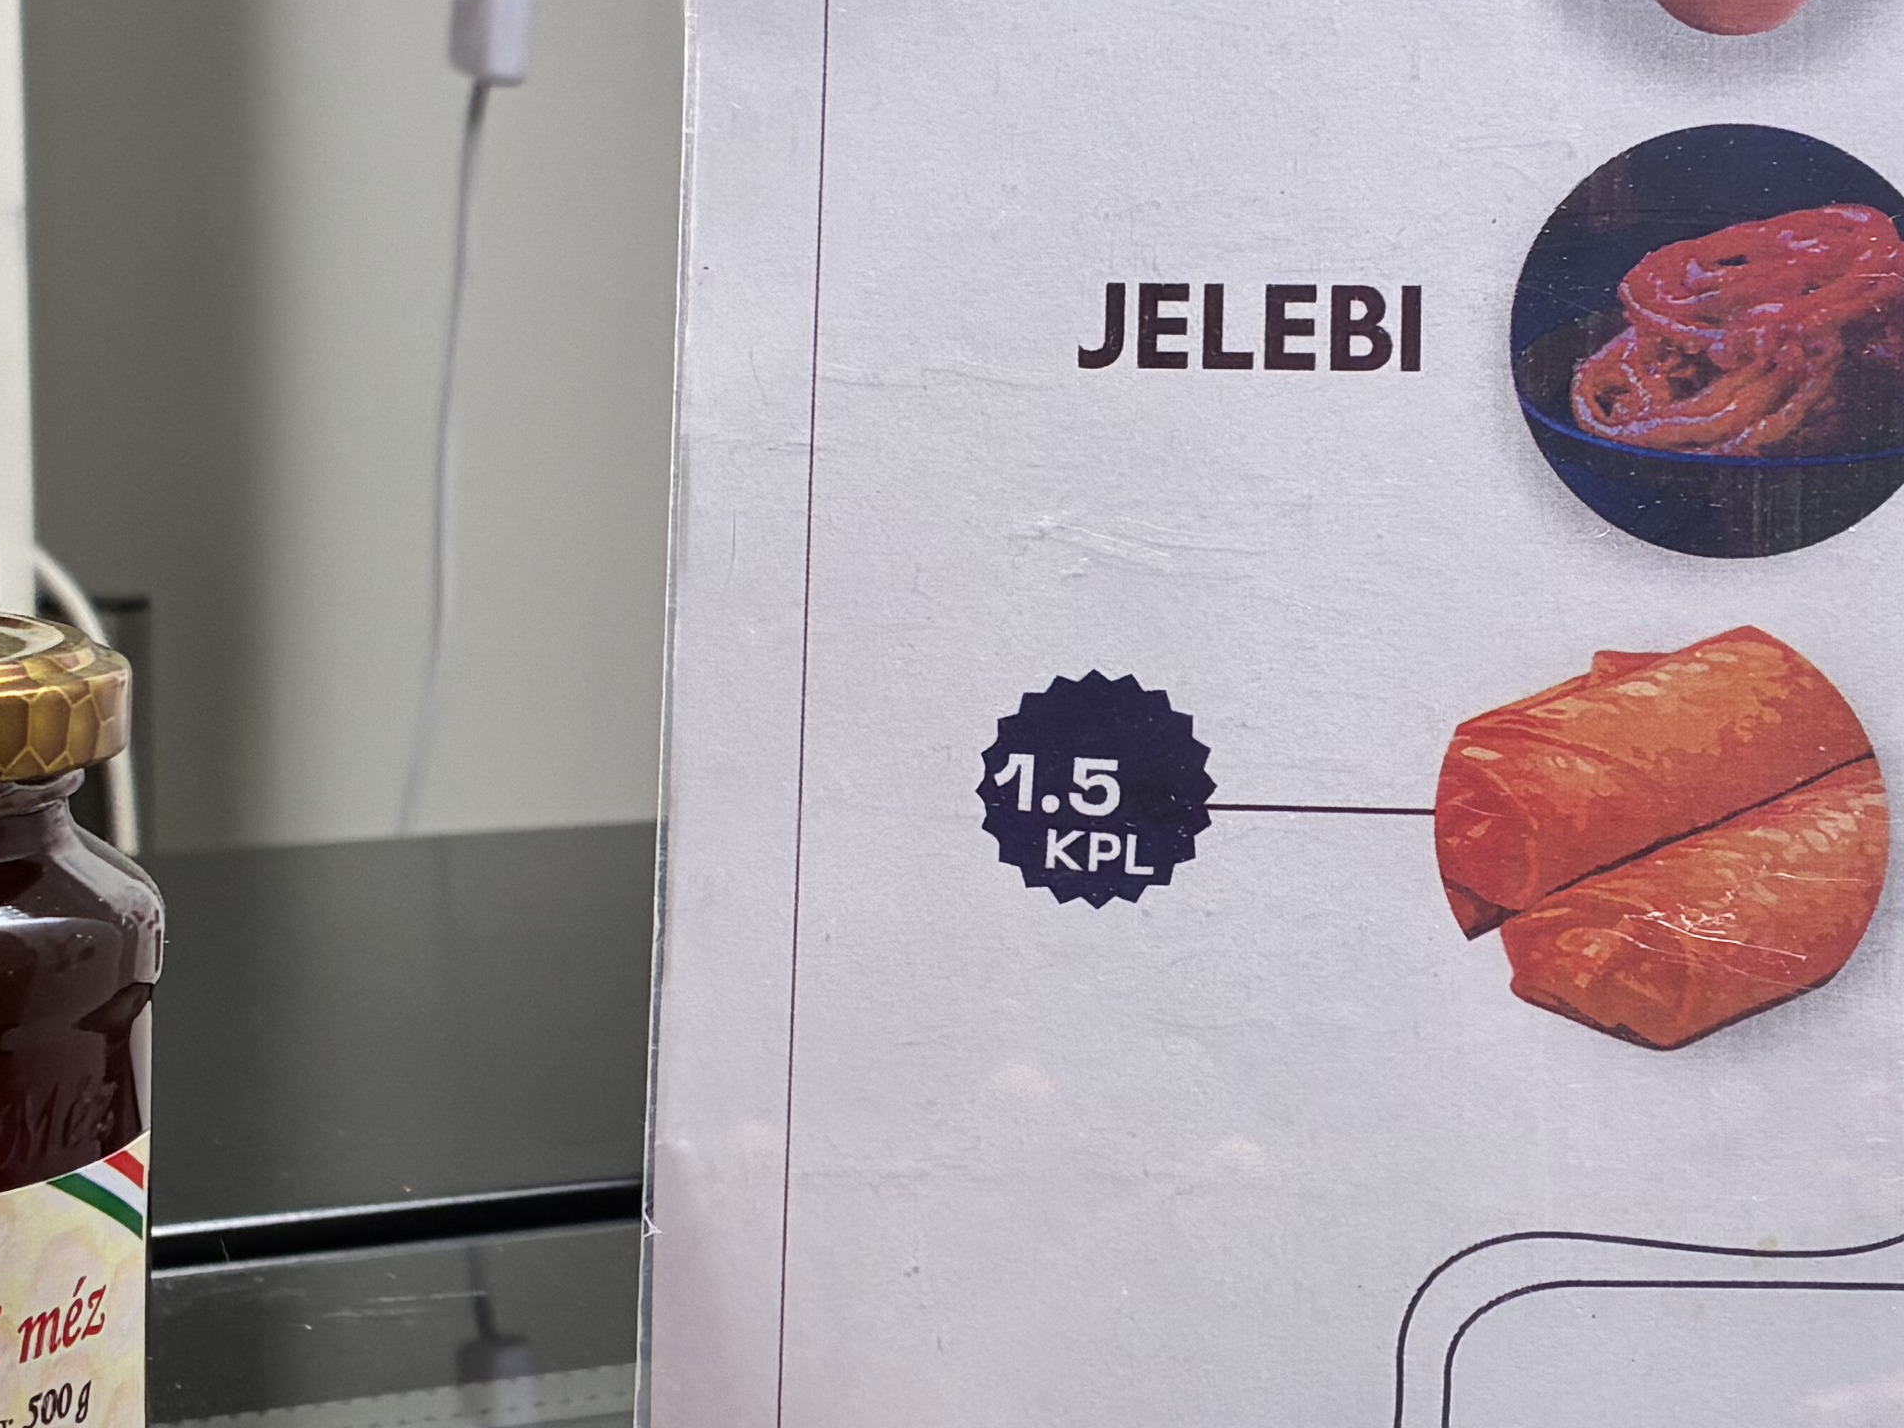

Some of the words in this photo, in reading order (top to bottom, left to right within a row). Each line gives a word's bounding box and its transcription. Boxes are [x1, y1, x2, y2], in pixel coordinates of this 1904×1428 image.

[1078, 283, 1421, 371] JELEBI
[994, 753, 1120, 816] 1.5
[1045, 828, 1154, 875] KPL
[18, 1276, 107, 1364] méz
[75, 1379, 92, 1424] g
